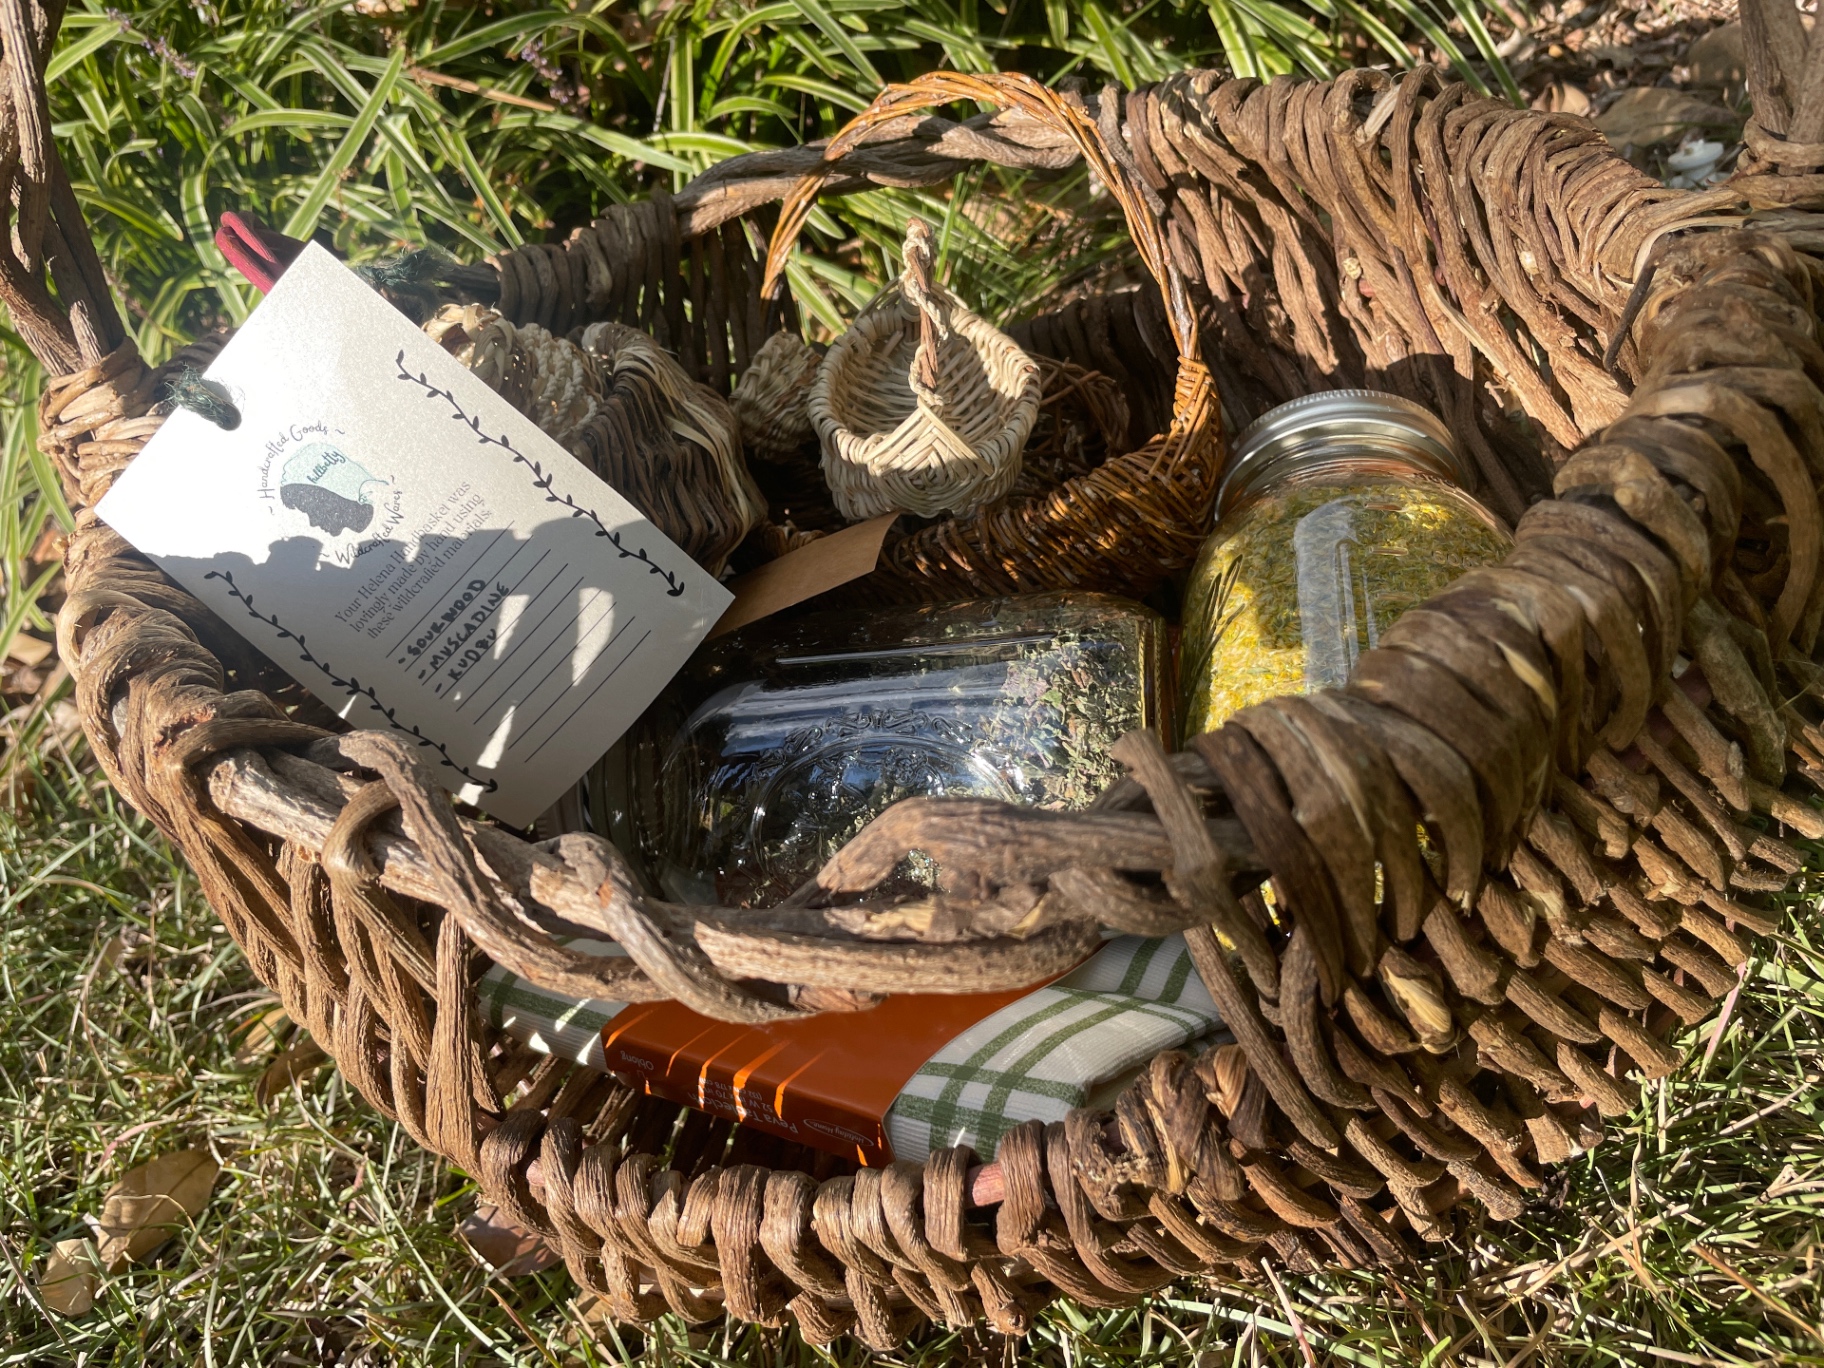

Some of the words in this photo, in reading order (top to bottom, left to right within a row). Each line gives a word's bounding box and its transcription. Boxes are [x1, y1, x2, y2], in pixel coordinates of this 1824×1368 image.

[257, 432, 289, 499] Handcrafted
[290, 420, 328, 442] Goods
[306, 451, 346, 484] hillbetty
[334, 595, 362, 624] Your
[357, 563, 396, 599] Helena
[394, 503, 451, 561] Handbasket
[448, 481, 471, 509] was
[335, 521, 393, 565] Wildcrafted
[384, 490, 404, 525] Wares
[349, 590, 390, 633] lovingly
[388, 563, 417, 595] made
[412, 548, 430, 571] by
[425, 522, 455, 556] hand
[452, 493, 486, 527] using
[367, 611, 396, 640] these
[392, 558, 446, 612] wildcrafted
[429, 582, 510, 671] MUSCADINE
[620, 1050, 654, 1071] Oblong
[763, 1112, 799, 1134] Peva
[813, 1122, 834, 1134] Home
